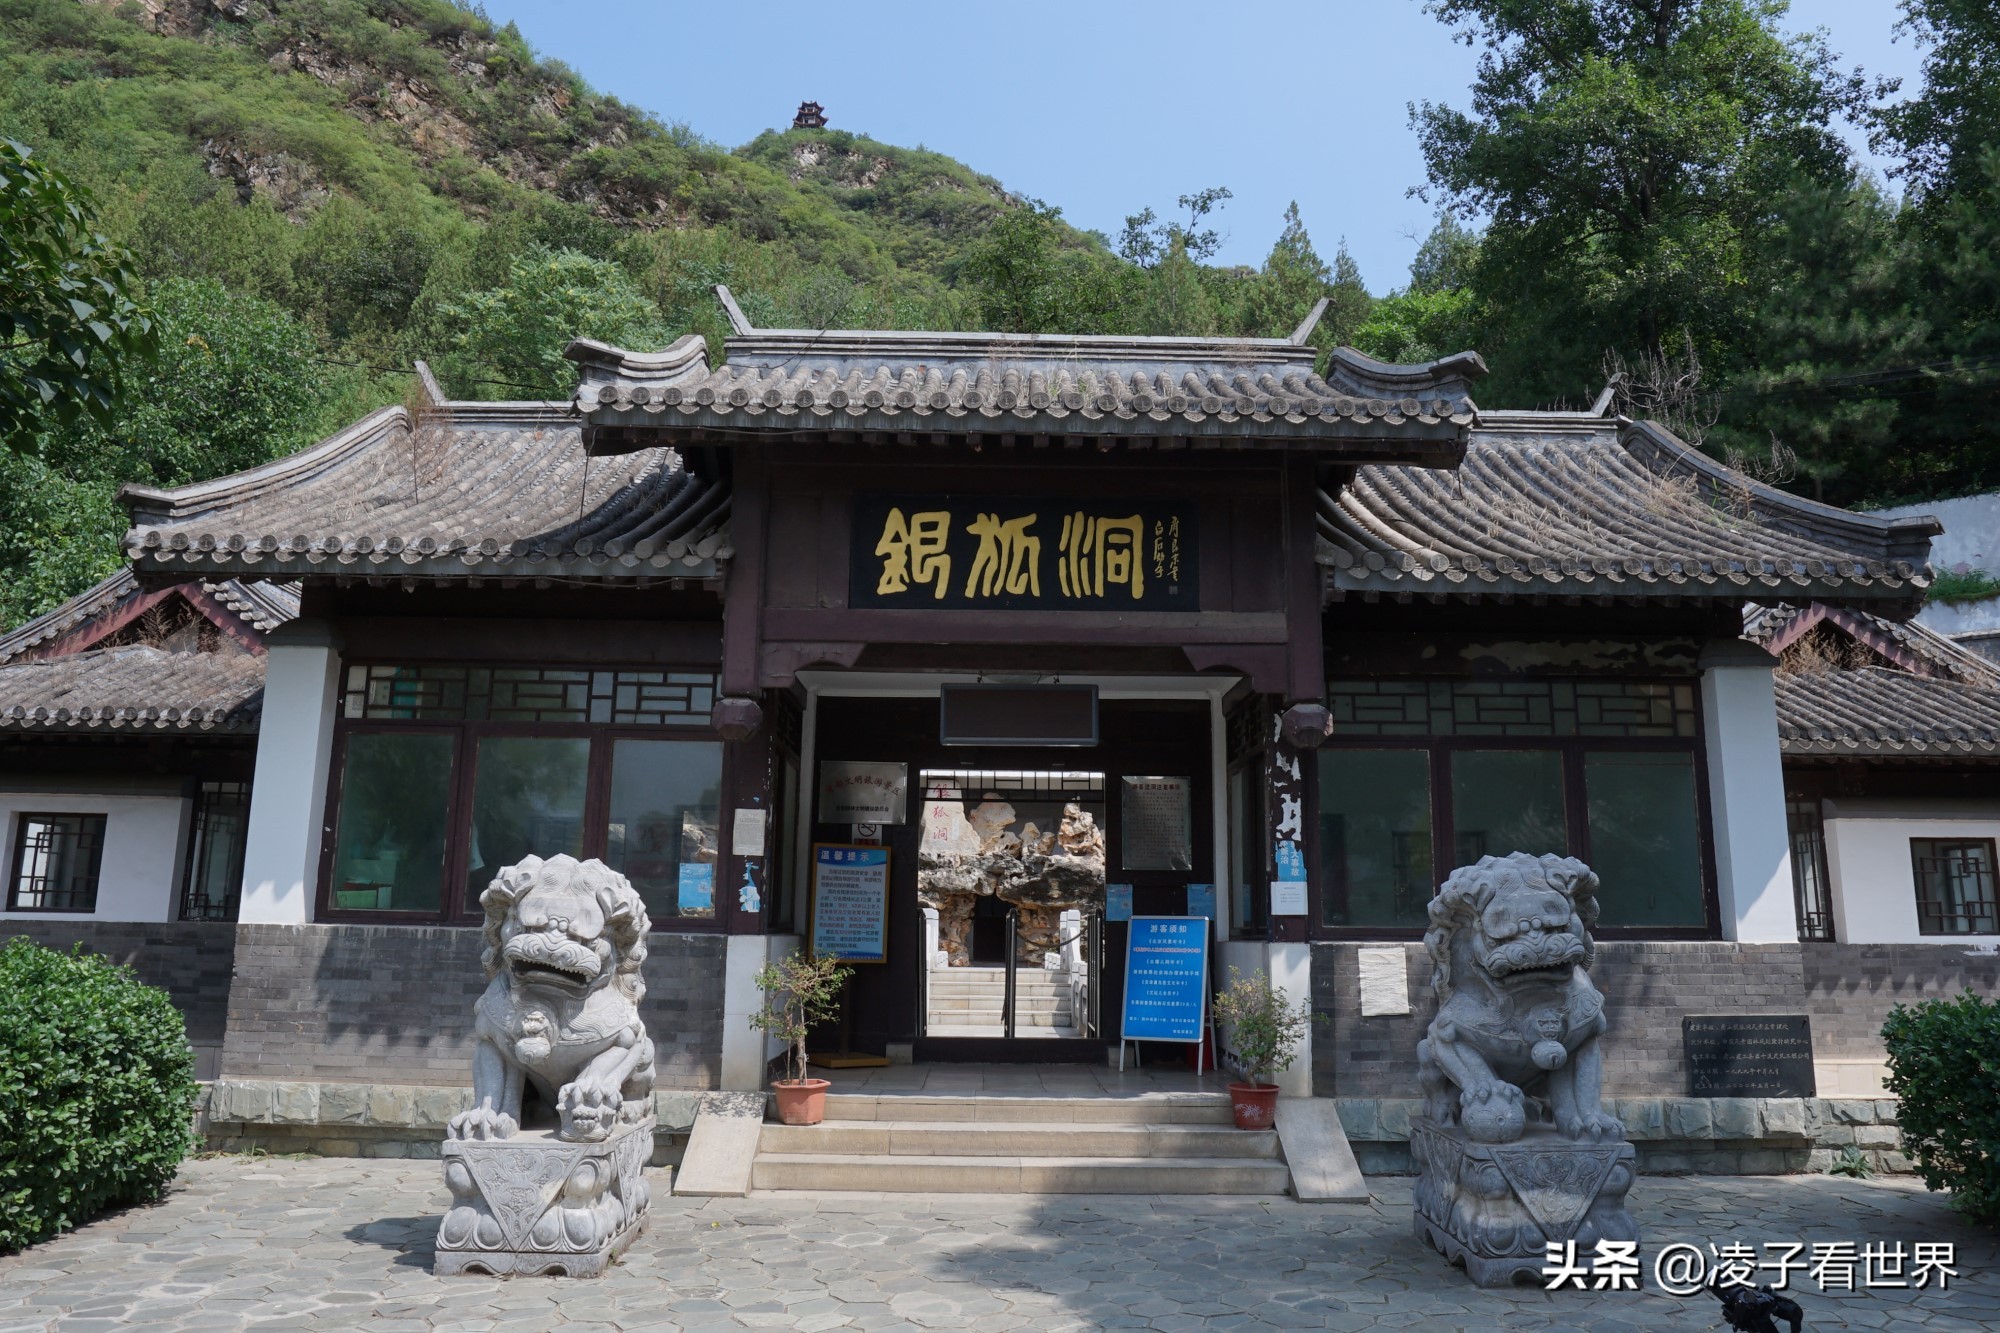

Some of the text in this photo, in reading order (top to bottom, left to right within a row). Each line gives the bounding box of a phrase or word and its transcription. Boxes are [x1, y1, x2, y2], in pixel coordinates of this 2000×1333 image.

[820, 850, 870, 862] 温馨提示
[1149, 924, 1187, 934] 游客须知
